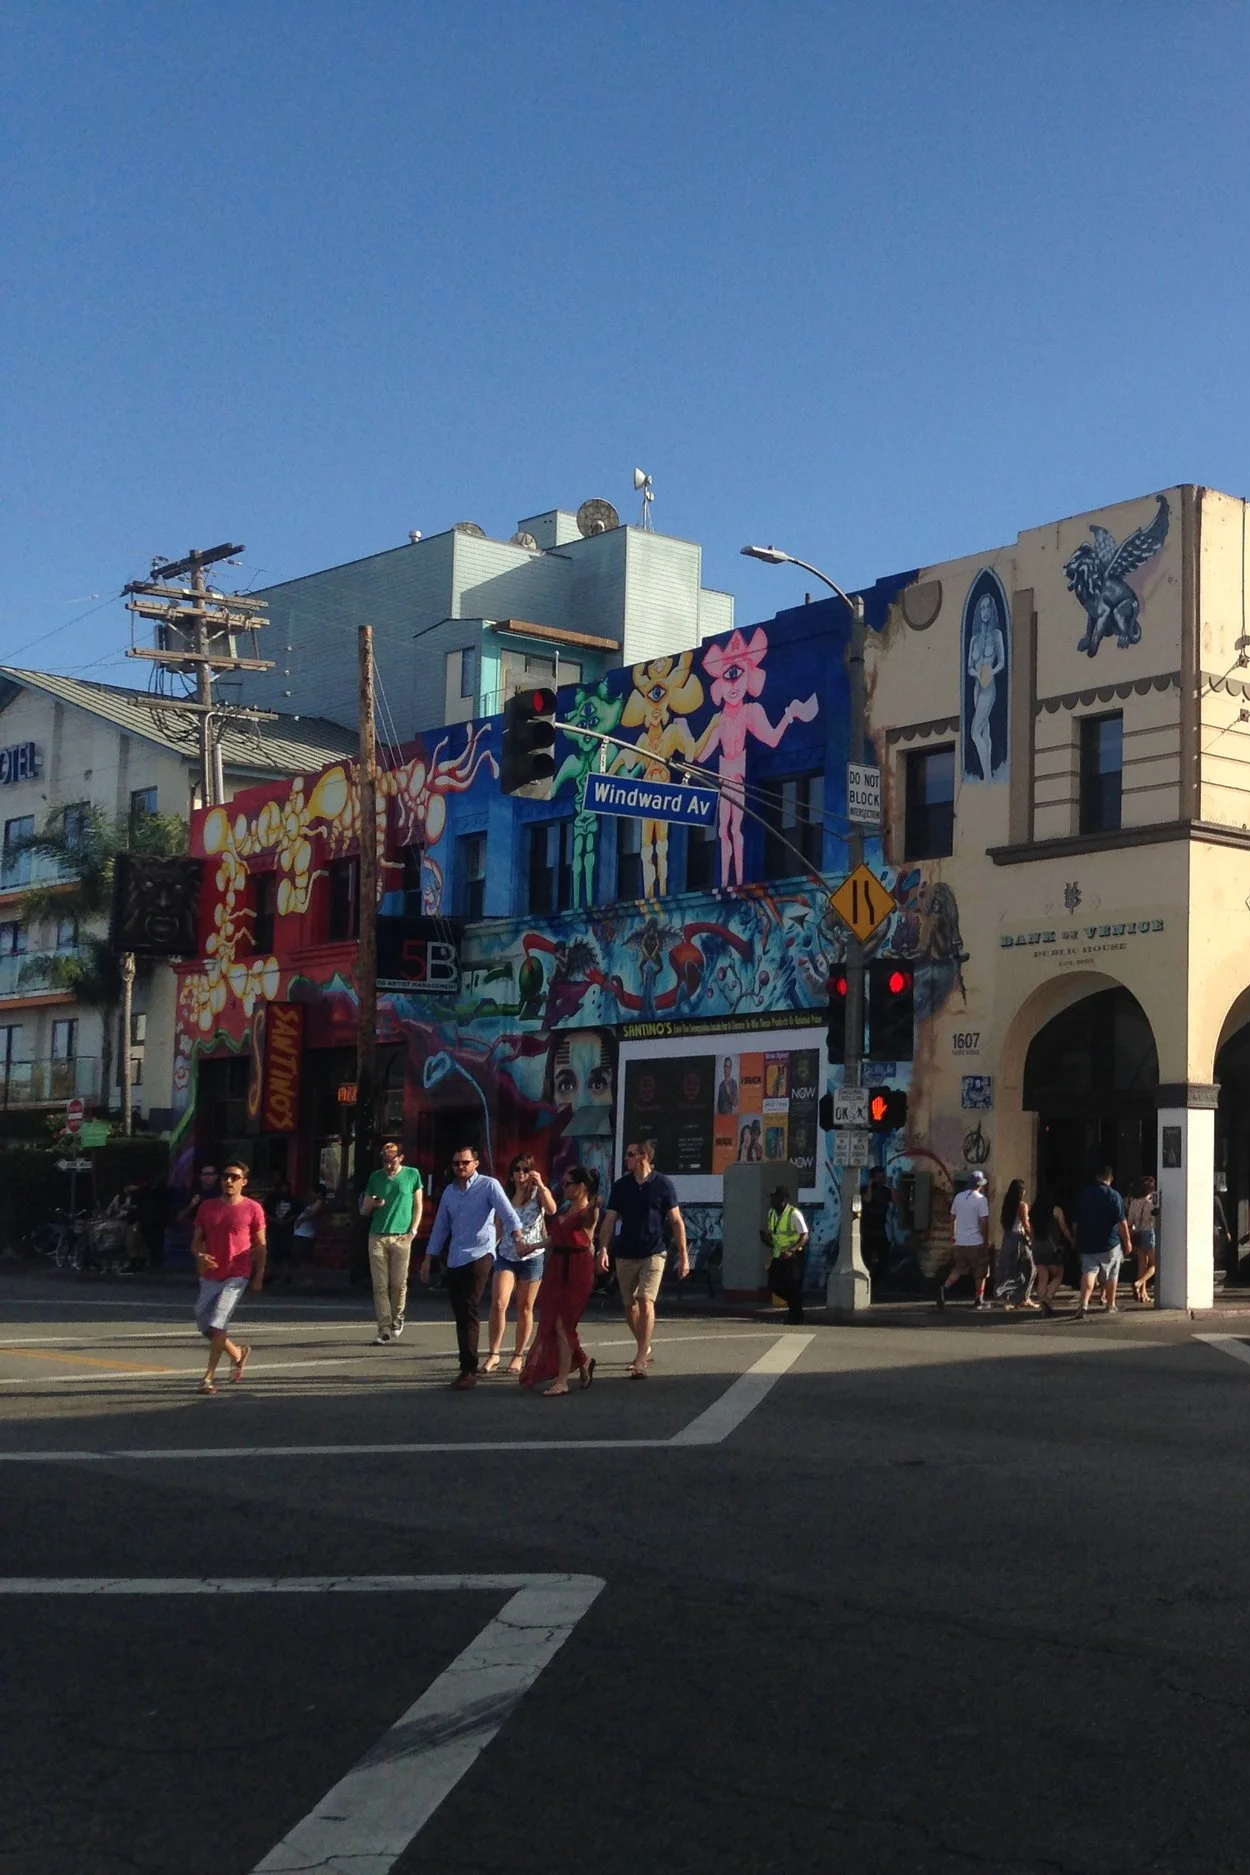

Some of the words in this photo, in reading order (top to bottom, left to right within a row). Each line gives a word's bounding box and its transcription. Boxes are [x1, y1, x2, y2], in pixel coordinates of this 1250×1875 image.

[850, 771, 860, 785] DO
[865, 773, 879, 787] NOT
[595, 782, 682, 812] Windward
[687, 796, 710, 815] Av
[850, 791, 879, 805] BLOCK
[1001, 931, 1056, 947] BANK
[1062, 931, 1078, 940] OF
[1083, 919, 1164, 939] VENICE
[1083, 943, 1128, 953] HOUSE
[623, 1022, 673, 1037] SANTINO'S
[953, 1032, 980, 1048] 1607
[265, 1005, 299, 1129] SANTINO'S
[791, 1087, 816, 1100] NOW
[835, 1107, 848, 1121] OK
[790, 1157, 814, 1168] NOW
